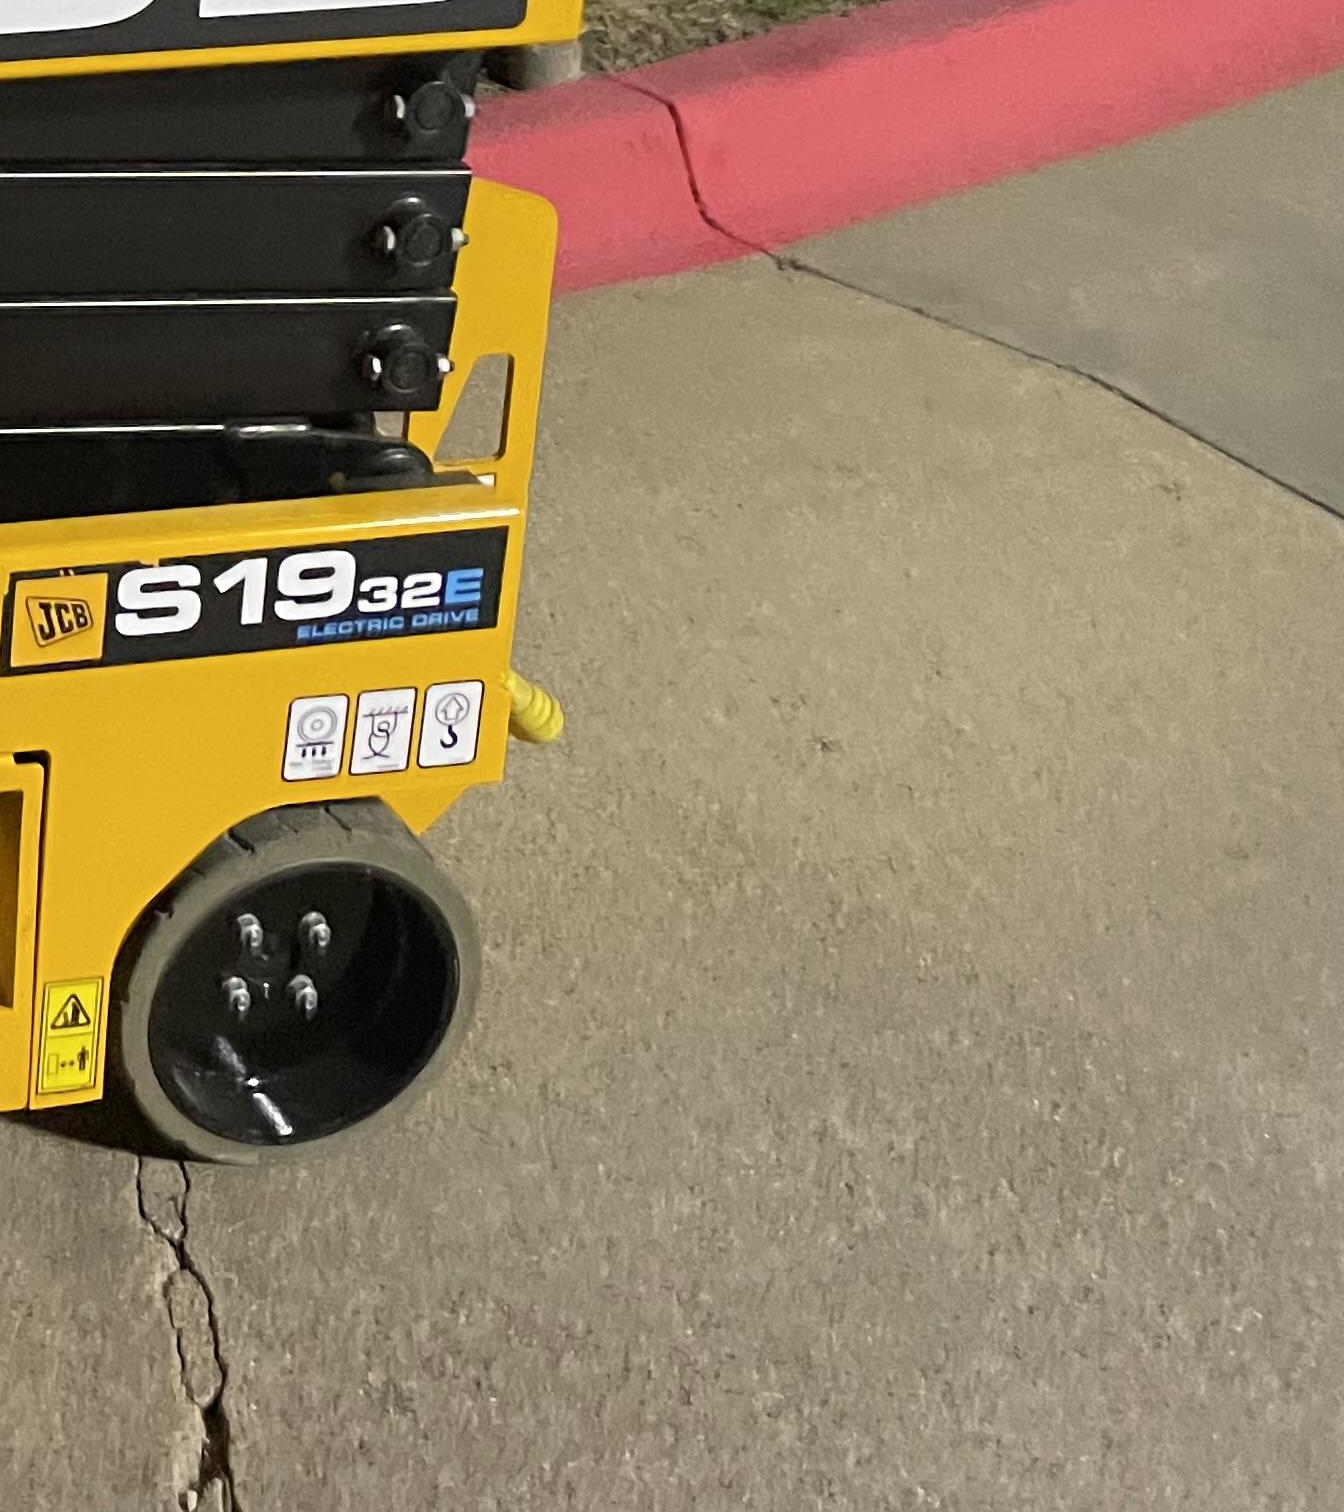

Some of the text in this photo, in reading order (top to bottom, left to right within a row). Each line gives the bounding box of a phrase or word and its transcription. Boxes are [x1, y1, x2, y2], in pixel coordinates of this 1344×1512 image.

[38, 602, 89, 641] JCB
[297, 608, 479, 640] ELECTRIC DRIVE
